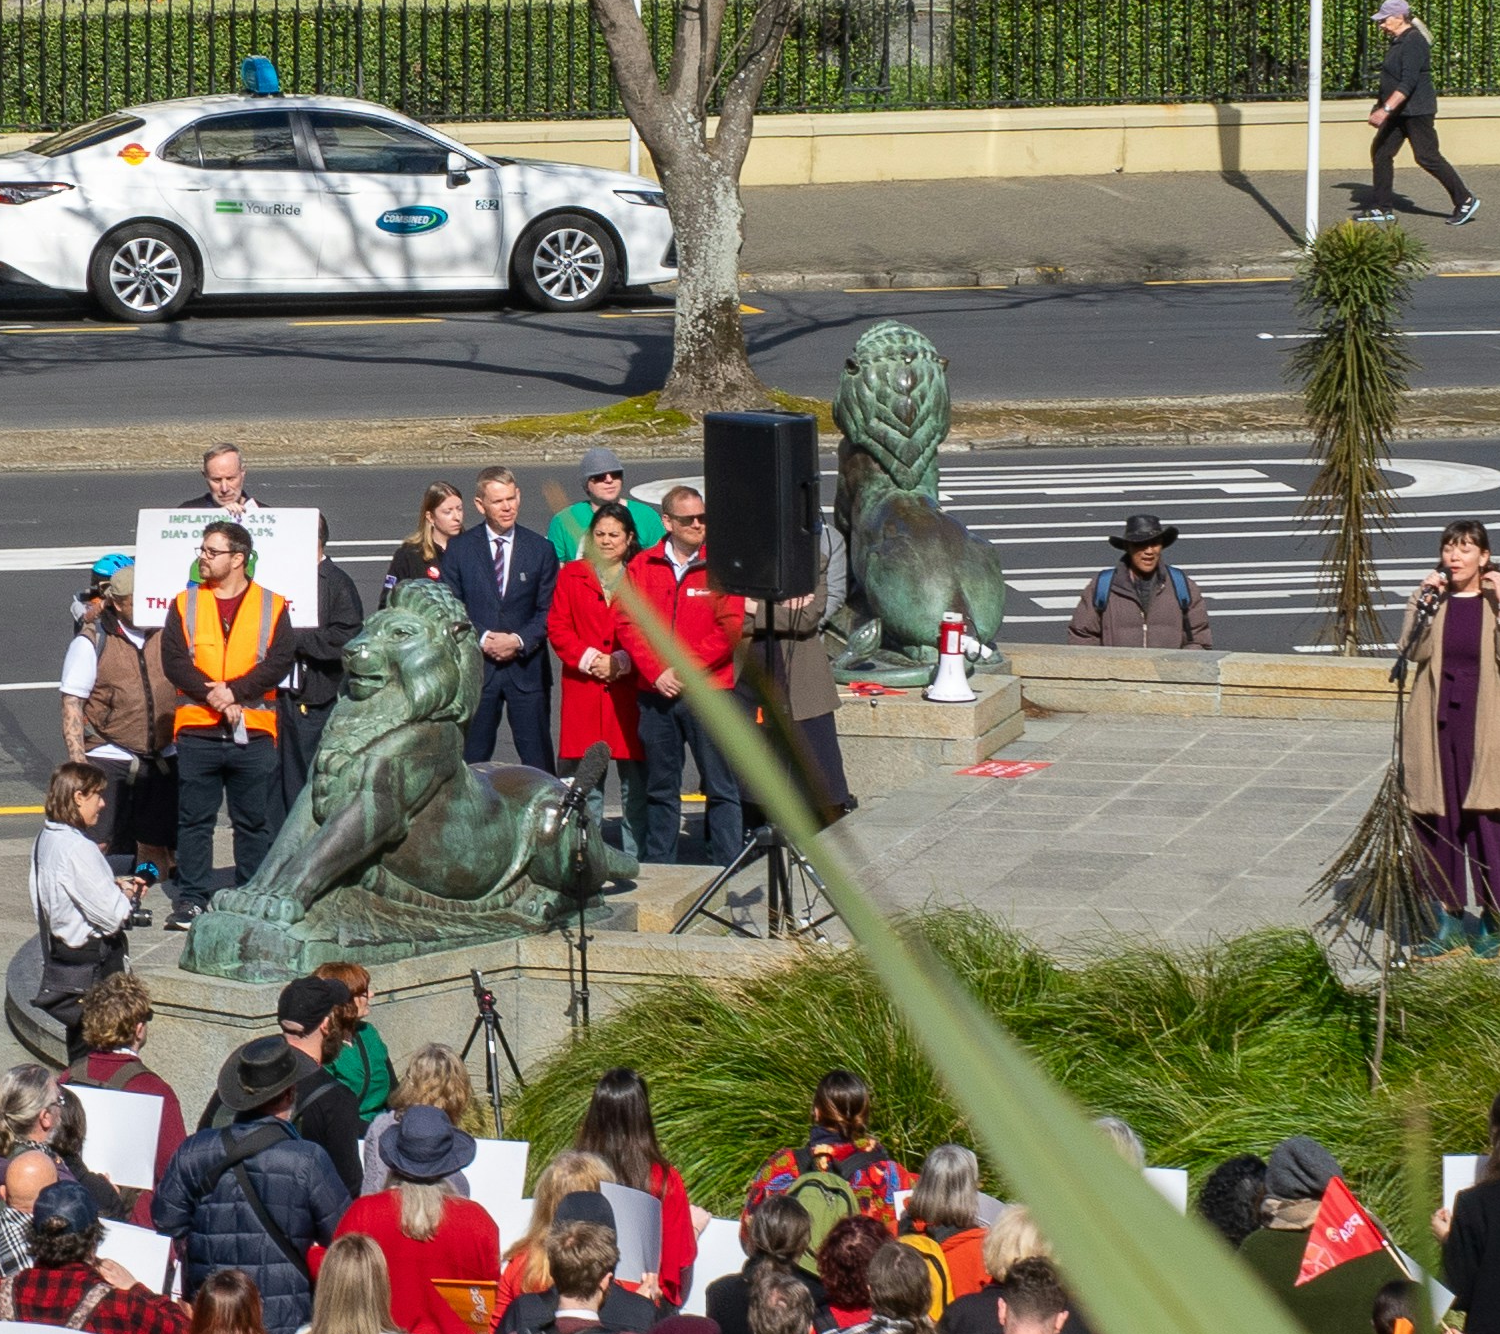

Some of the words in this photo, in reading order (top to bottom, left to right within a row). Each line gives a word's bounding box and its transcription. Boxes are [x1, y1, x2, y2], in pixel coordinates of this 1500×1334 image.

[246, 202, 301, 216] YourRide
[383, 214, 430, 225] COMBINED
[248, 513, 277, 525] 3.1%
[161, 529, 188, 540] DIA's
